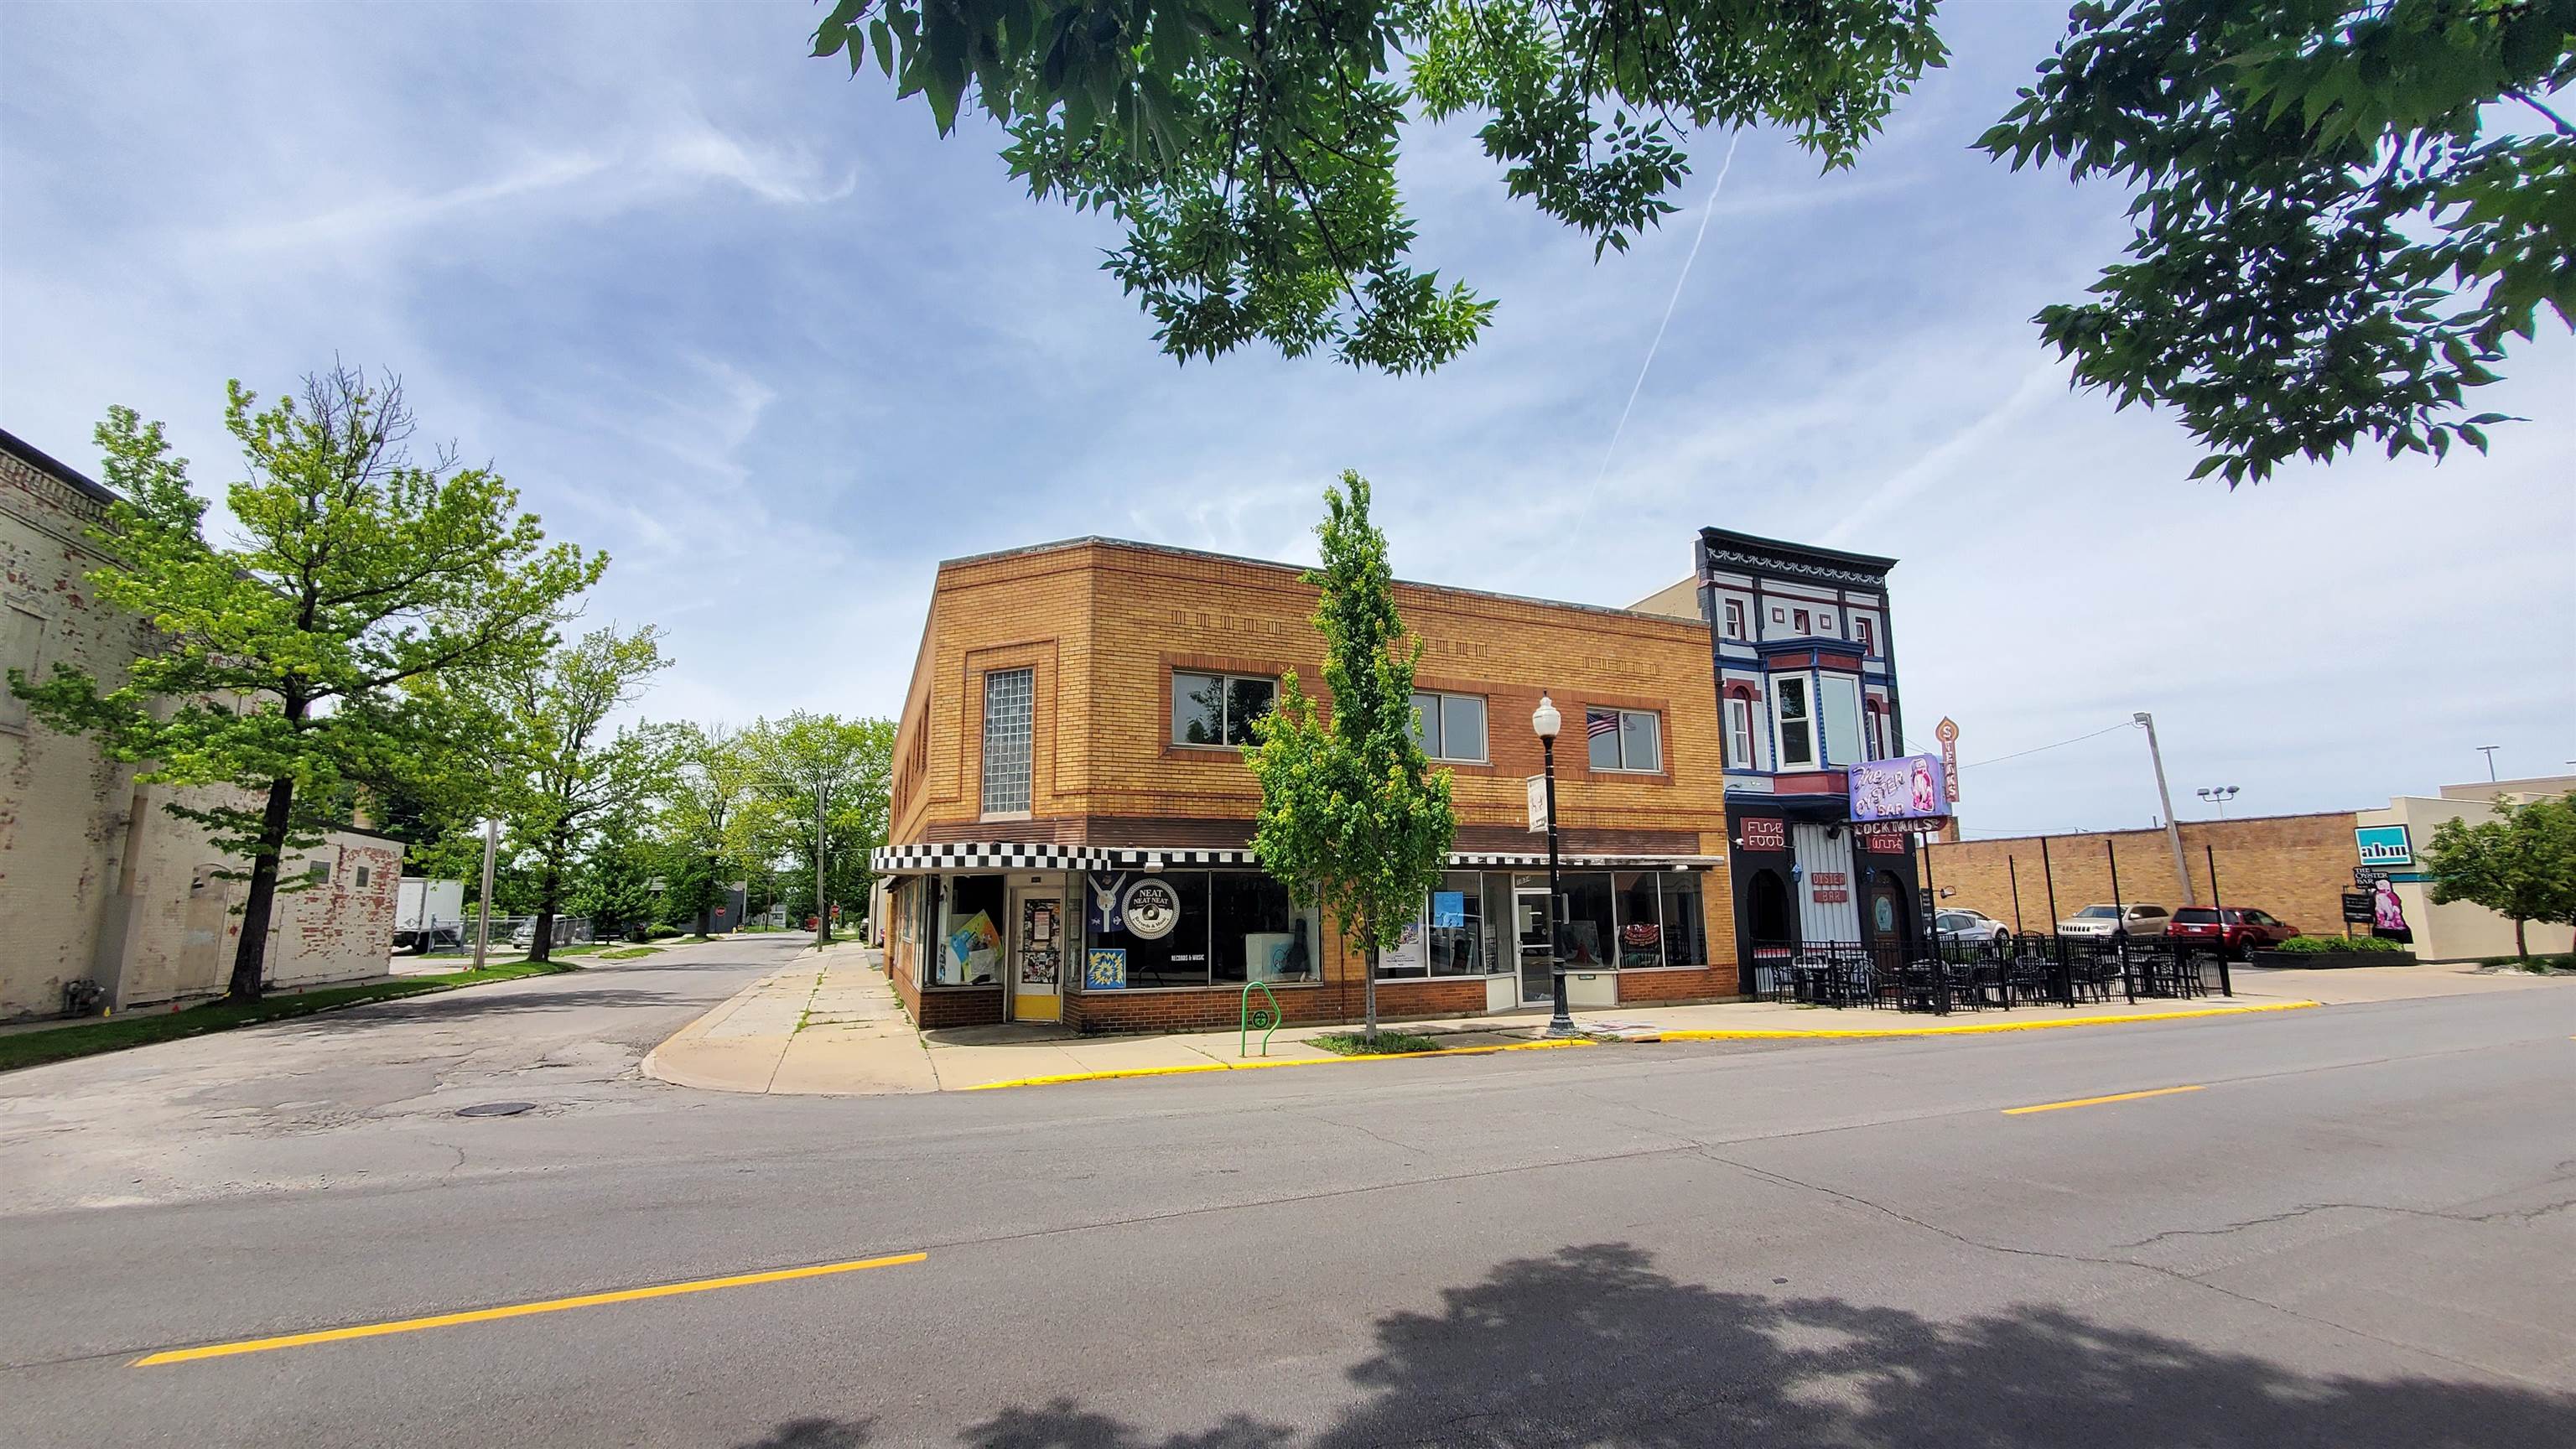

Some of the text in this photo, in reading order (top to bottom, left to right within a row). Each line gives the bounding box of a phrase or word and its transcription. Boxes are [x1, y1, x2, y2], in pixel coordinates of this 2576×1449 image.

[1942, 725, 1956, 796] STEAKS
[1852, 766, 1883, 792] The
[1856, 771, 1905, 818] OYSTER
[1877, 802, 1904, 817] BAR
[1854, 819, 1932, 835] COCKTAILS
[1749, 834, 1784, 846] FOOD
[2360, 843, 2407, 857] abm
[1813, 874, 1845, 884] OYSTER
[1822, 891, 1840, 901] BAR
